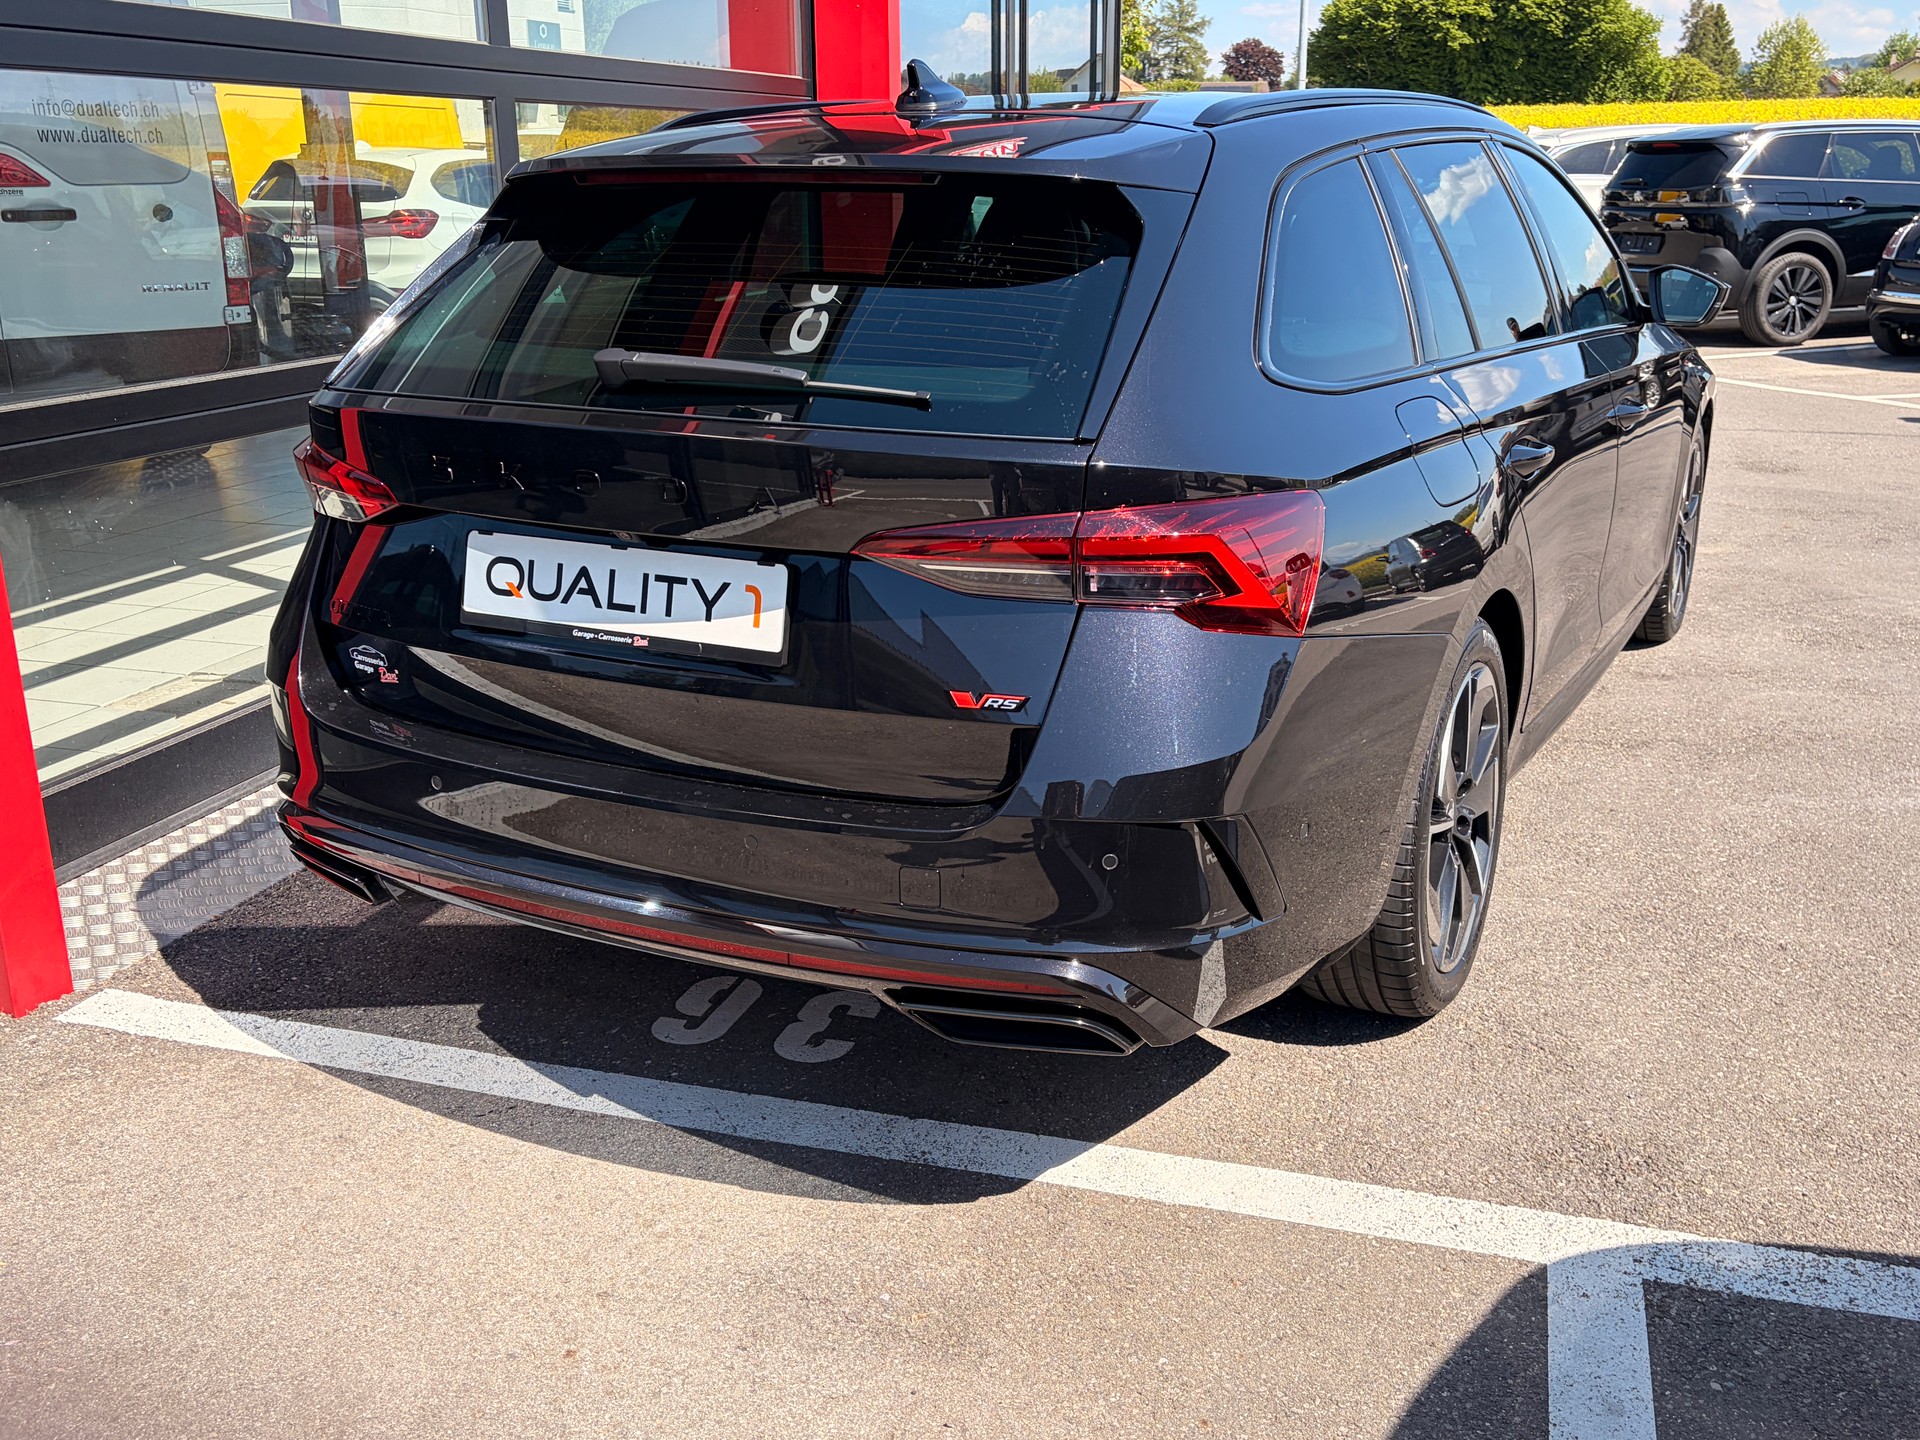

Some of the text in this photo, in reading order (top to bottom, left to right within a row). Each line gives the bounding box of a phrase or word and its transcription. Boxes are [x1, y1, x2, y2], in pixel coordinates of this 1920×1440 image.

[31, 98, 160, 118] info@dualtech.ch
[36, 126, 164, 144] www.dualtech.ch
[141, 282, 211, 293] RENAULT
[485, 555, 732, 623] QUALITY
[572, 628, 594, 640] Garage
[598, 632, 633, 645] Carrosserie
[353, 651, 385, 667] Carrosserie
[354, 660, 375, 674] Garage
